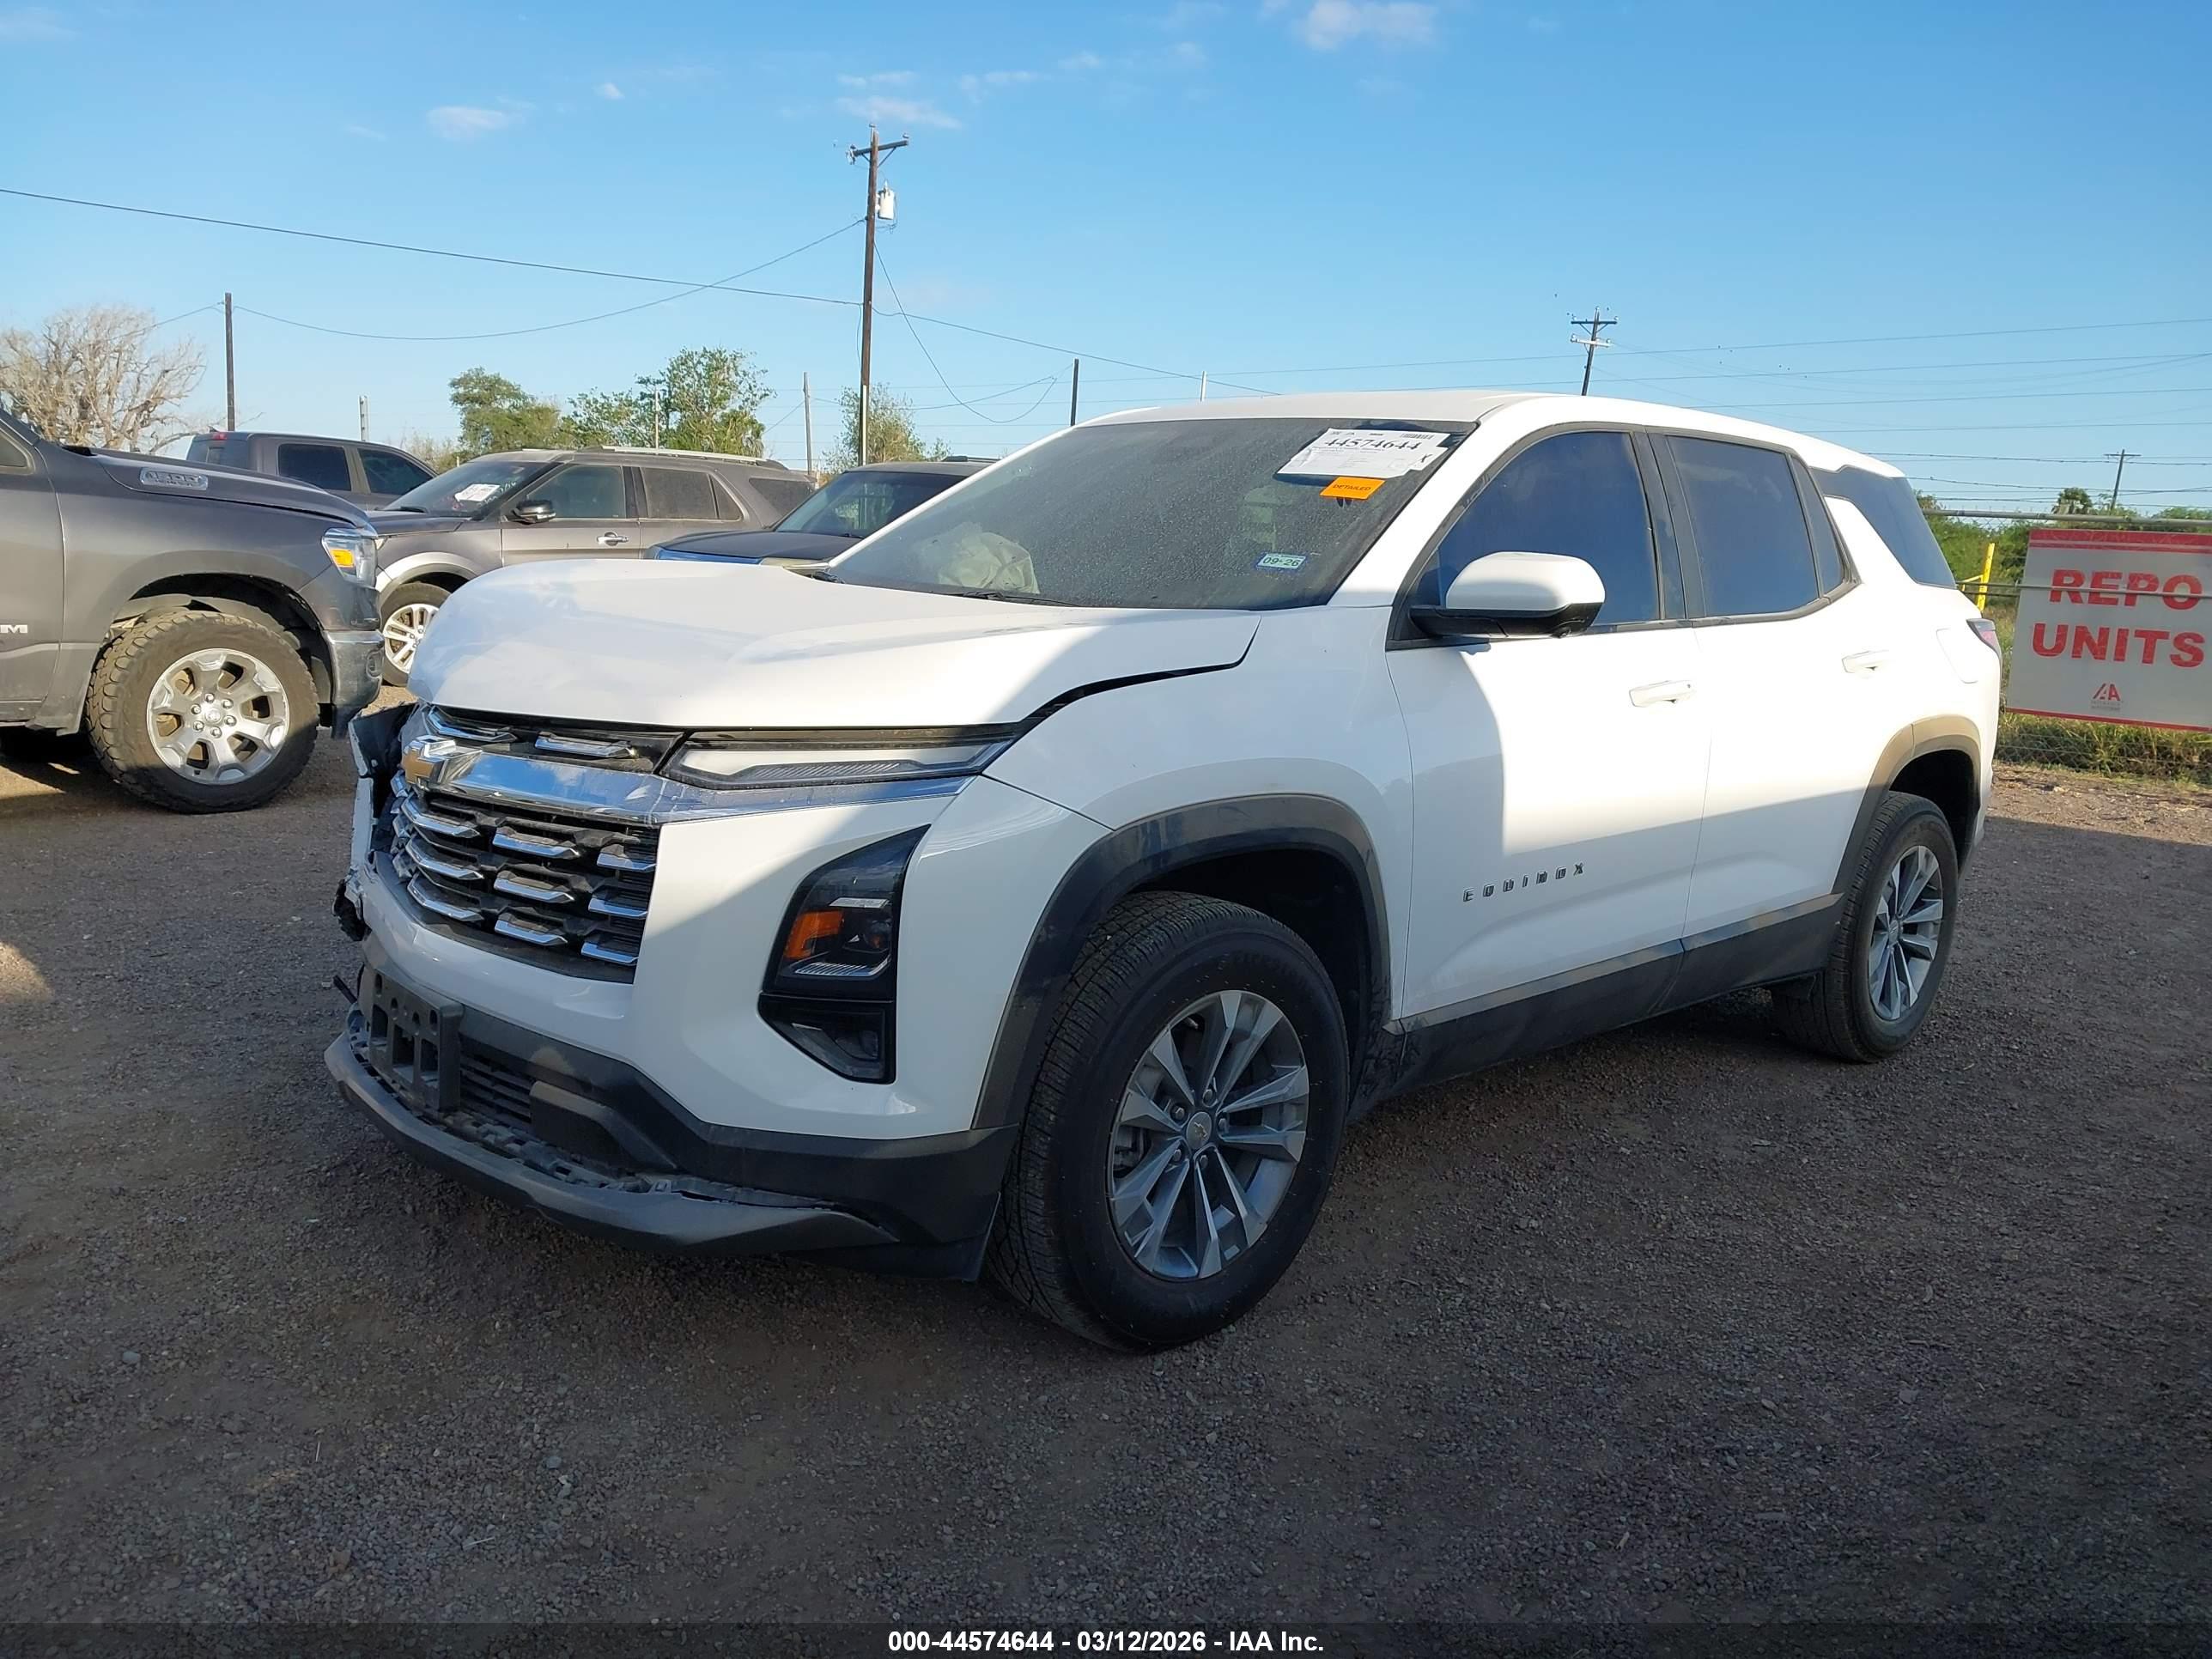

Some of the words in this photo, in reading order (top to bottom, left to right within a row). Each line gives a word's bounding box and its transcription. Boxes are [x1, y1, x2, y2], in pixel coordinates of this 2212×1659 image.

[1324, 438, 1422, 450] 44574644
[2049, 569, 2203, 610] REPO
[2032, 623, 2205, 668] UNITS
[1462, 862, 1584, 902] EQUINOX
